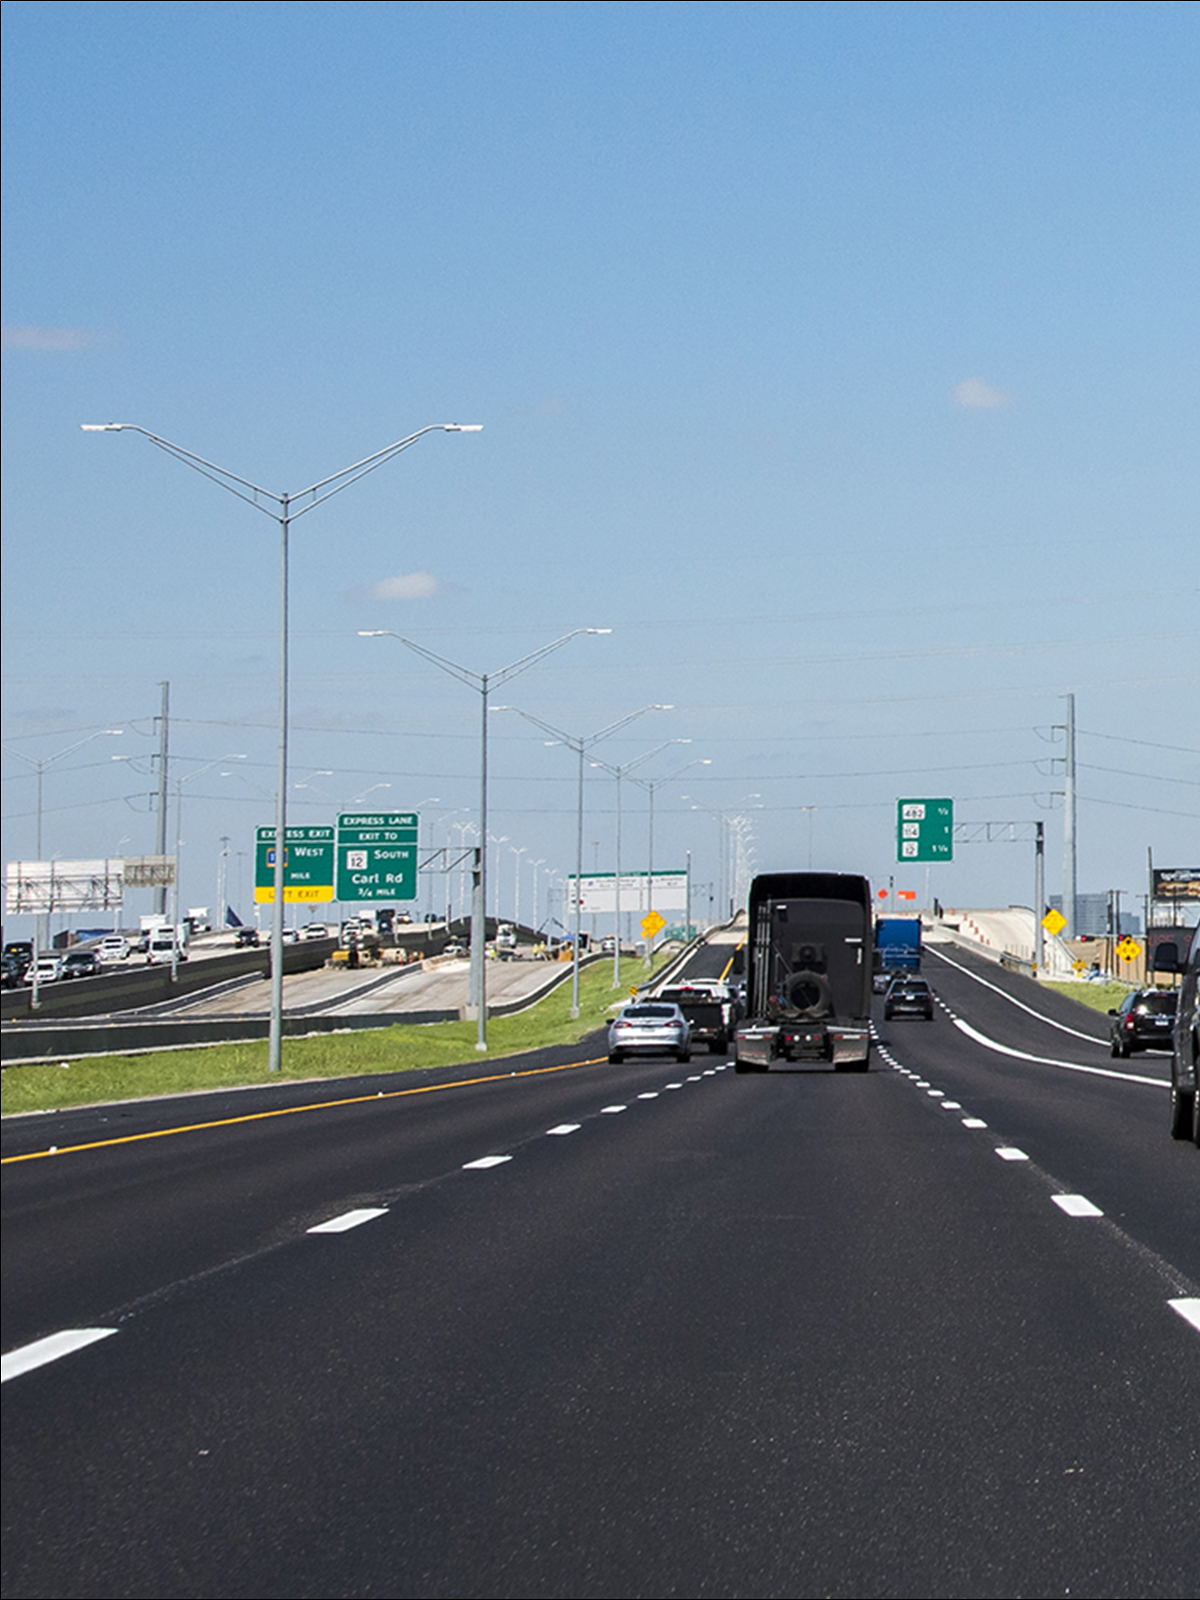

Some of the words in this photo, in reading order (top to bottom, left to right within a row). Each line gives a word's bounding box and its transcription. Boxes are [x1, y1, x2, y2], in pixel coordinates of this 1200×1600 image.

[343, 817, 385, 825] EXPRESS
[388, 816, 413, 825] LANE
[261, 829, 305, 838] EXESS
[308, 829, 331, 838] EXIT
[358, 832, 380, 841] EXIT
[384, 832, 398, 840] TO
[350, 856, 364, 868] 12
[290, 872, 311, 880] MILE
[351, 873, 380, 884] Carl
[386, 872, 404, 884] Rd
[268, 890, 293, 899] LT
[298, 890, 320, 898] EXIT
[375, 888, 396, 896] MILE
